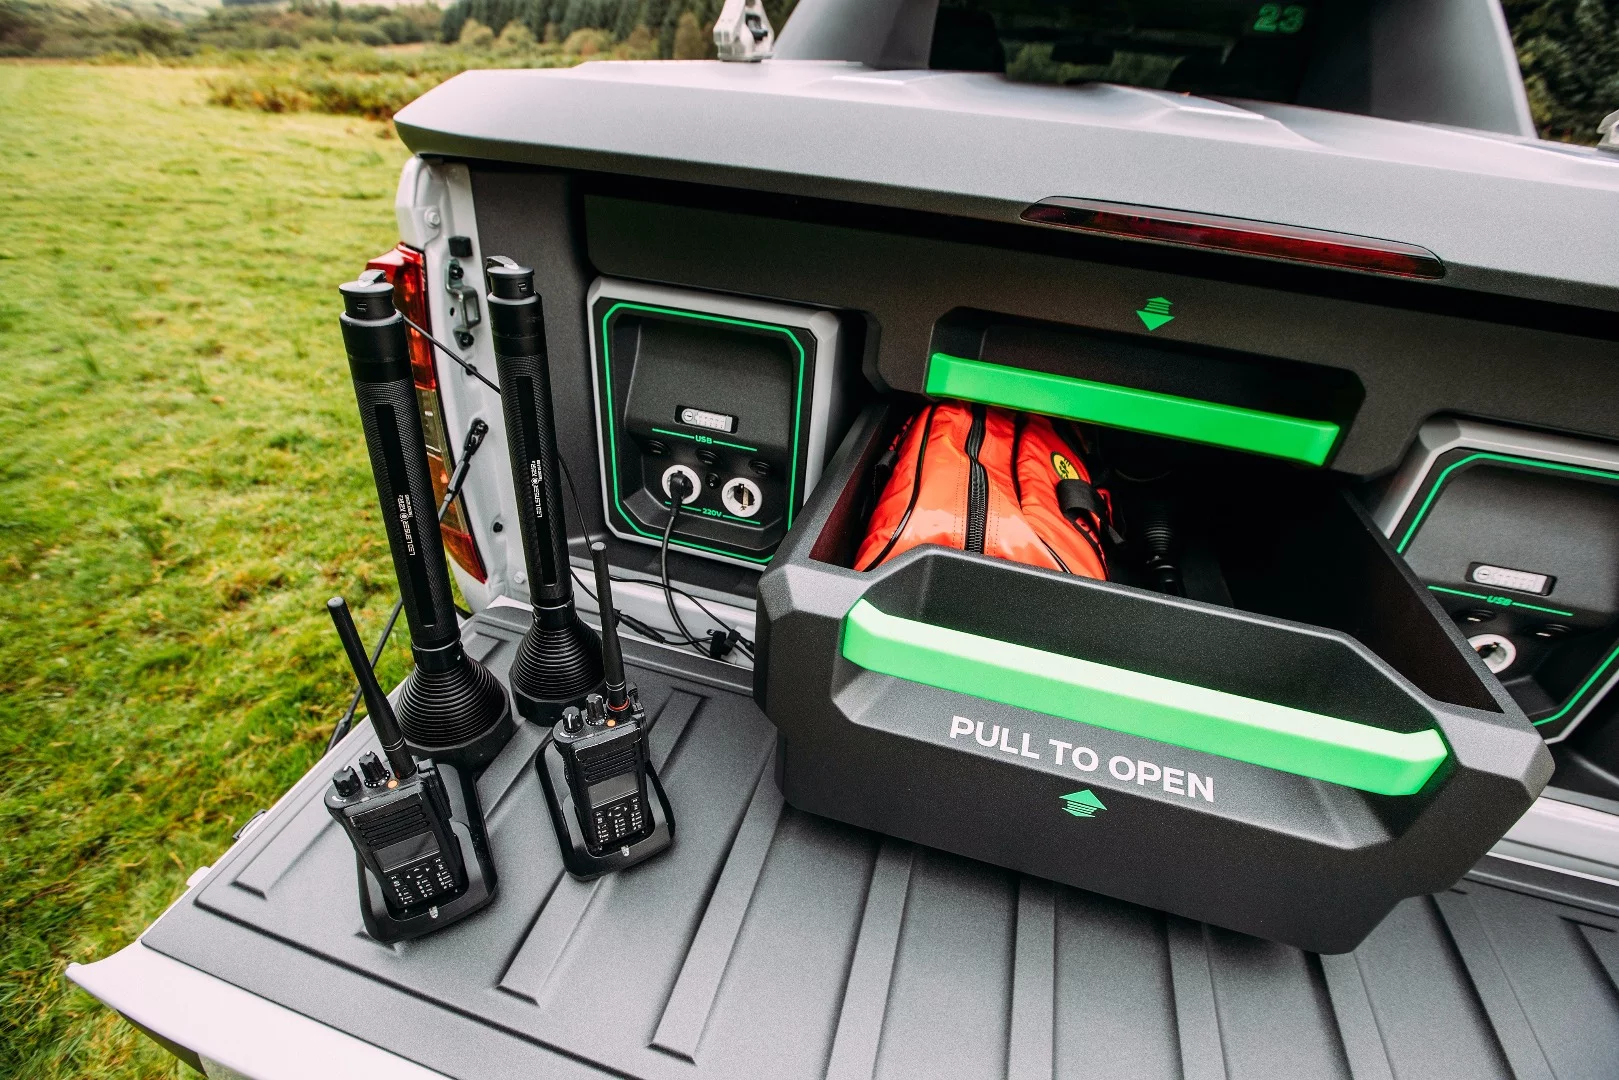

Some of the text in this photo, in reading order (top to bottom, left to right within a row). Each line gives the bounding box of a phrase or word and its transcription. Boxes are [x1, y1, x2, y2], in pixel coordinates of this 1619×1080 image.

[1253, 3, 1305, 34] 23
[695, 434, 713, 444] USB
[702, 507, 723, 518] 220V
[407, 544, 416, 556] LED
[1486, 595, 1513, 607] USB
[949, 715, 1214, 803] PULL TO OPEN
